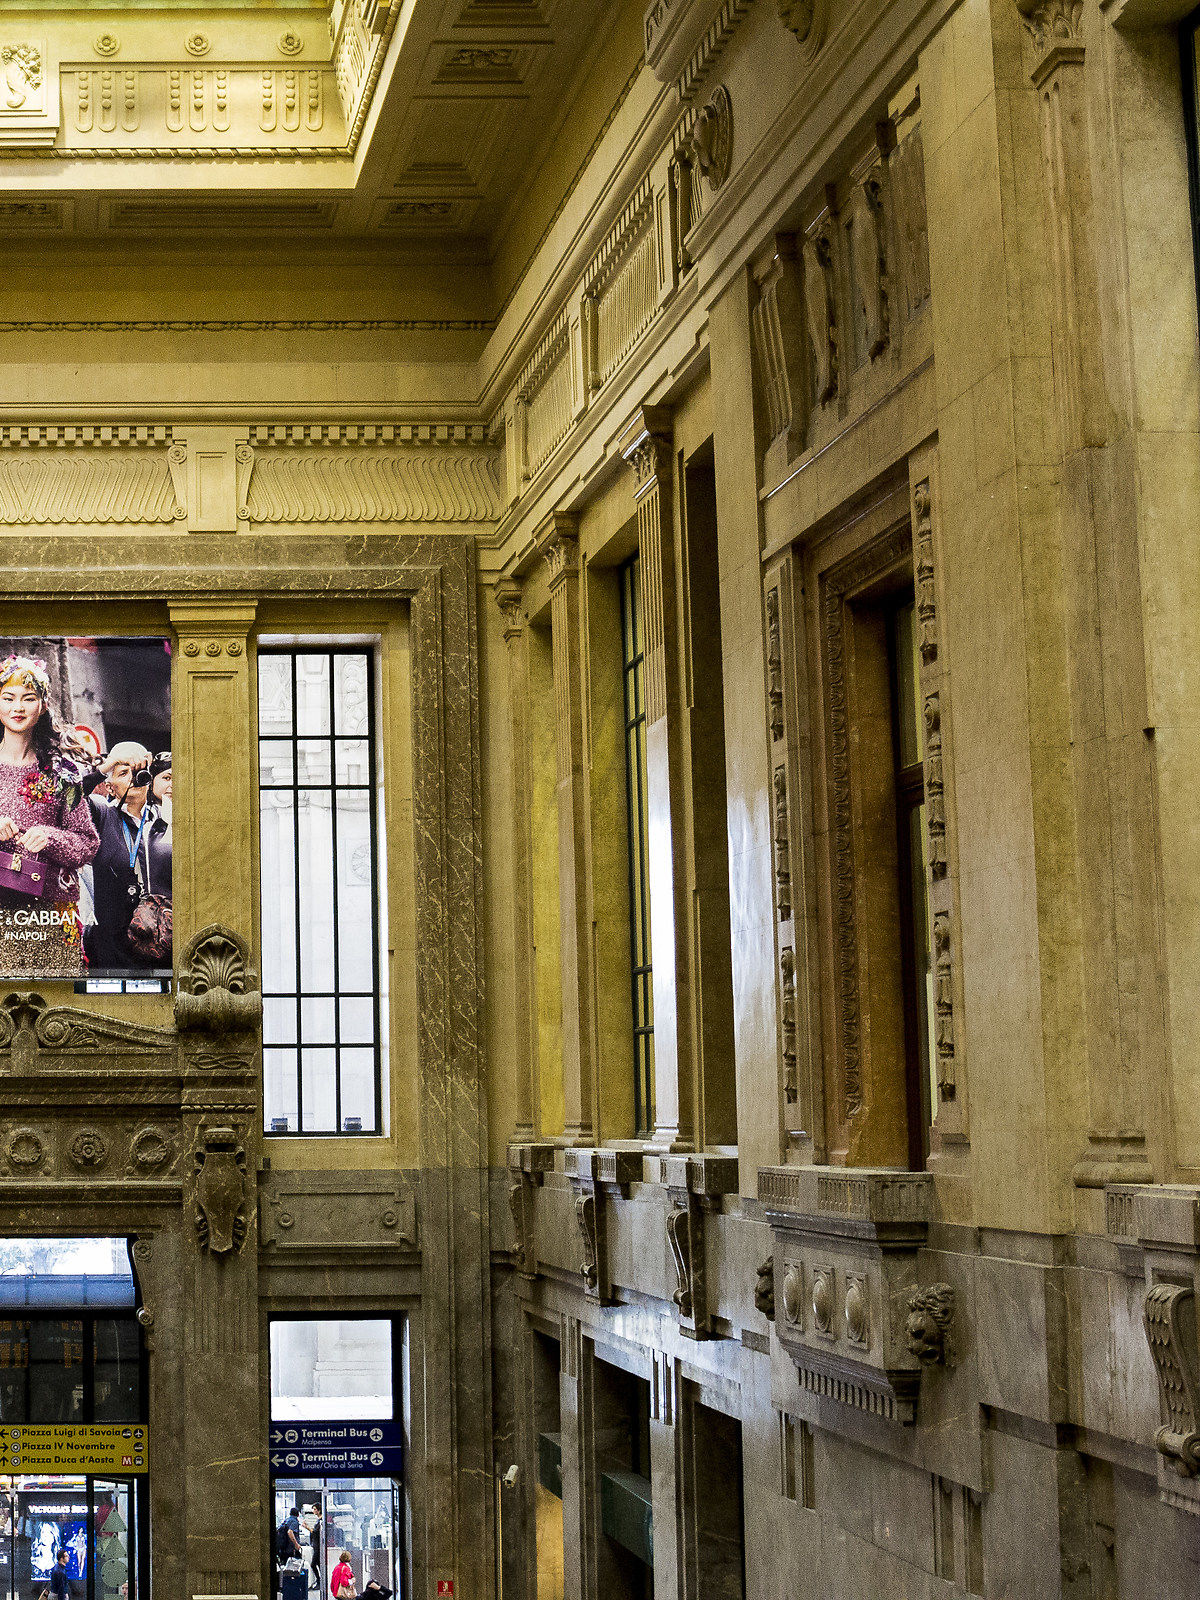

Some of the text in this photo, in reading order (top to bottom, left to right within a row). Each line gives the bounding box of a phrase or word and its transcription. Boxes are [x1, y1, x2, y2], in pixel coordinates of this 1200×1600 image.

[5, 916, 13, 925] &
[13, 909, 99, 926] GABBANA
[4, 931, 47, 941] #NAPOLI
[22, 1428, 121, 1438] Piazza Luigi di Savoia
[301, 1428, 368, 1438] Terminal Bus
[22, 1442, 116, 1450] Piazza IV Novembre
[22, 1456, 52, 1464] Piazza
[54, 1456, 77, 1464] Duca
[79, 1456, 114, 1464] d'Aosta
[302, 1452, 369, 1462] Terminal Bus
